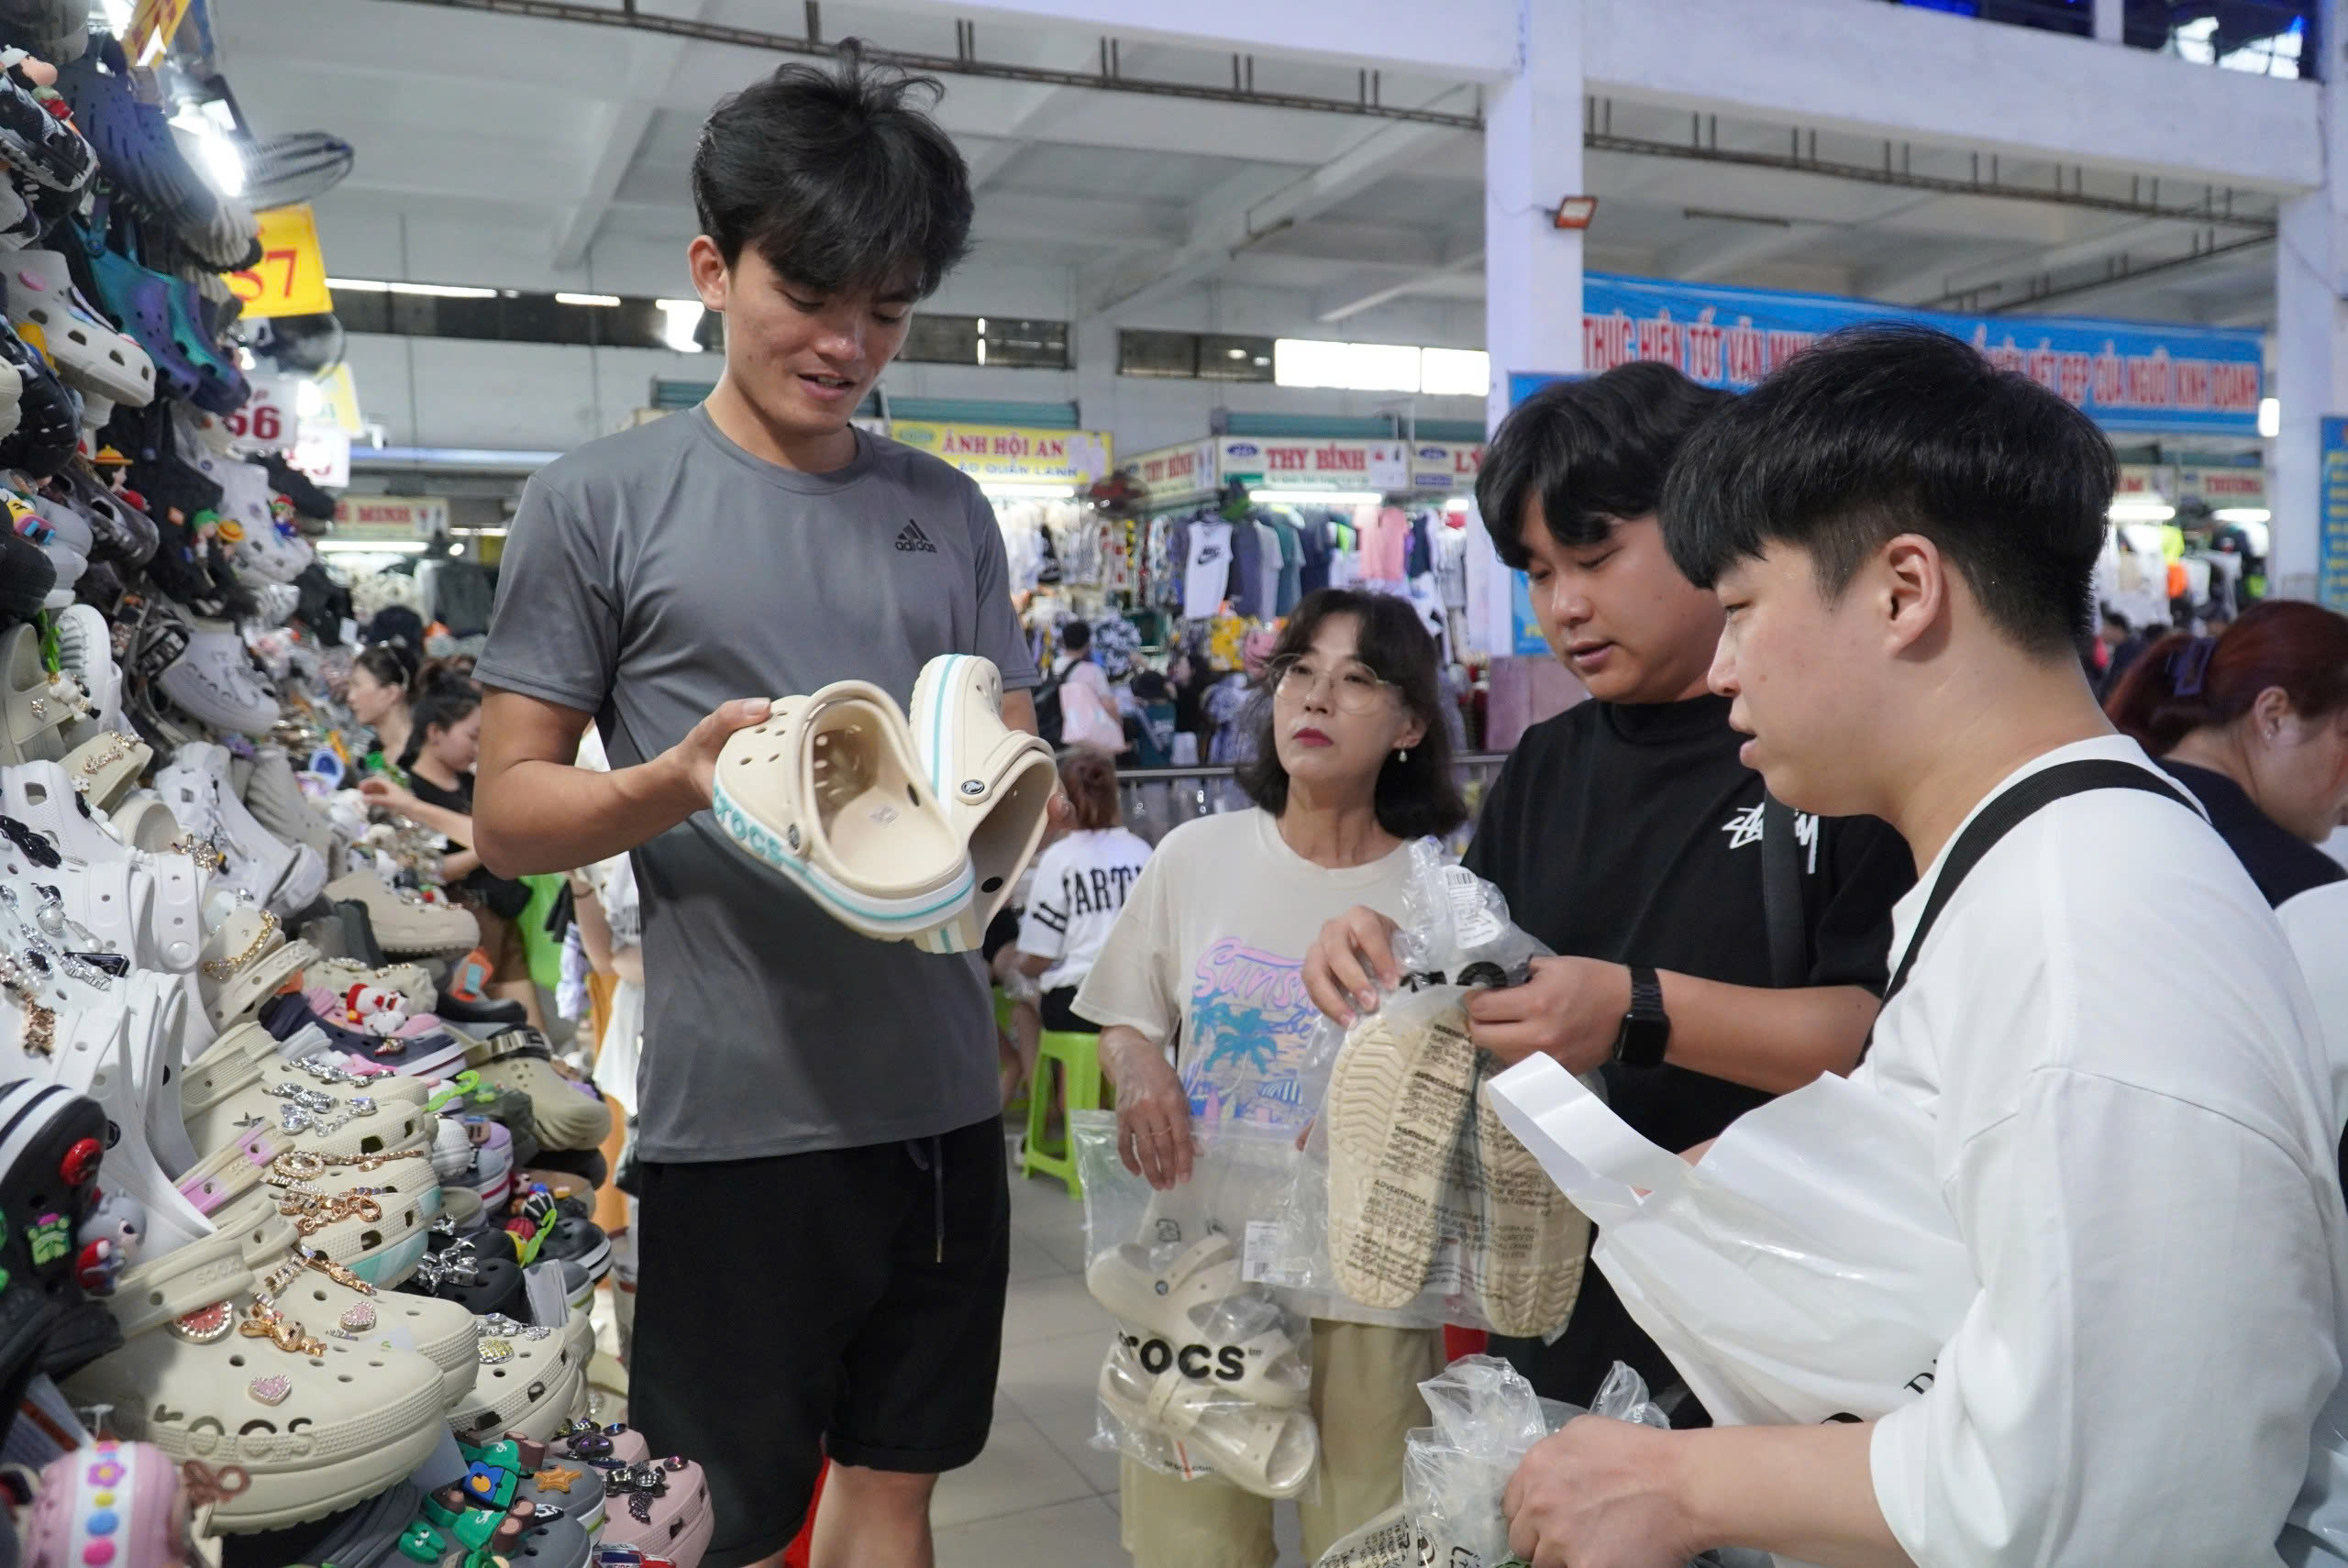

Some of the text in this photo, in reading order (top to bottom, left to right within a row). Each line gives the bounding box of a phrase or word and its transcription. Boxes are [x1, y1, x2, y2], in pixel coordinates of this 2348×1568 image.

[1036, 439, 1064, 457] AN
[1266, 447, 1308, 470] THY
[895, 539, 937, 553] adidas
